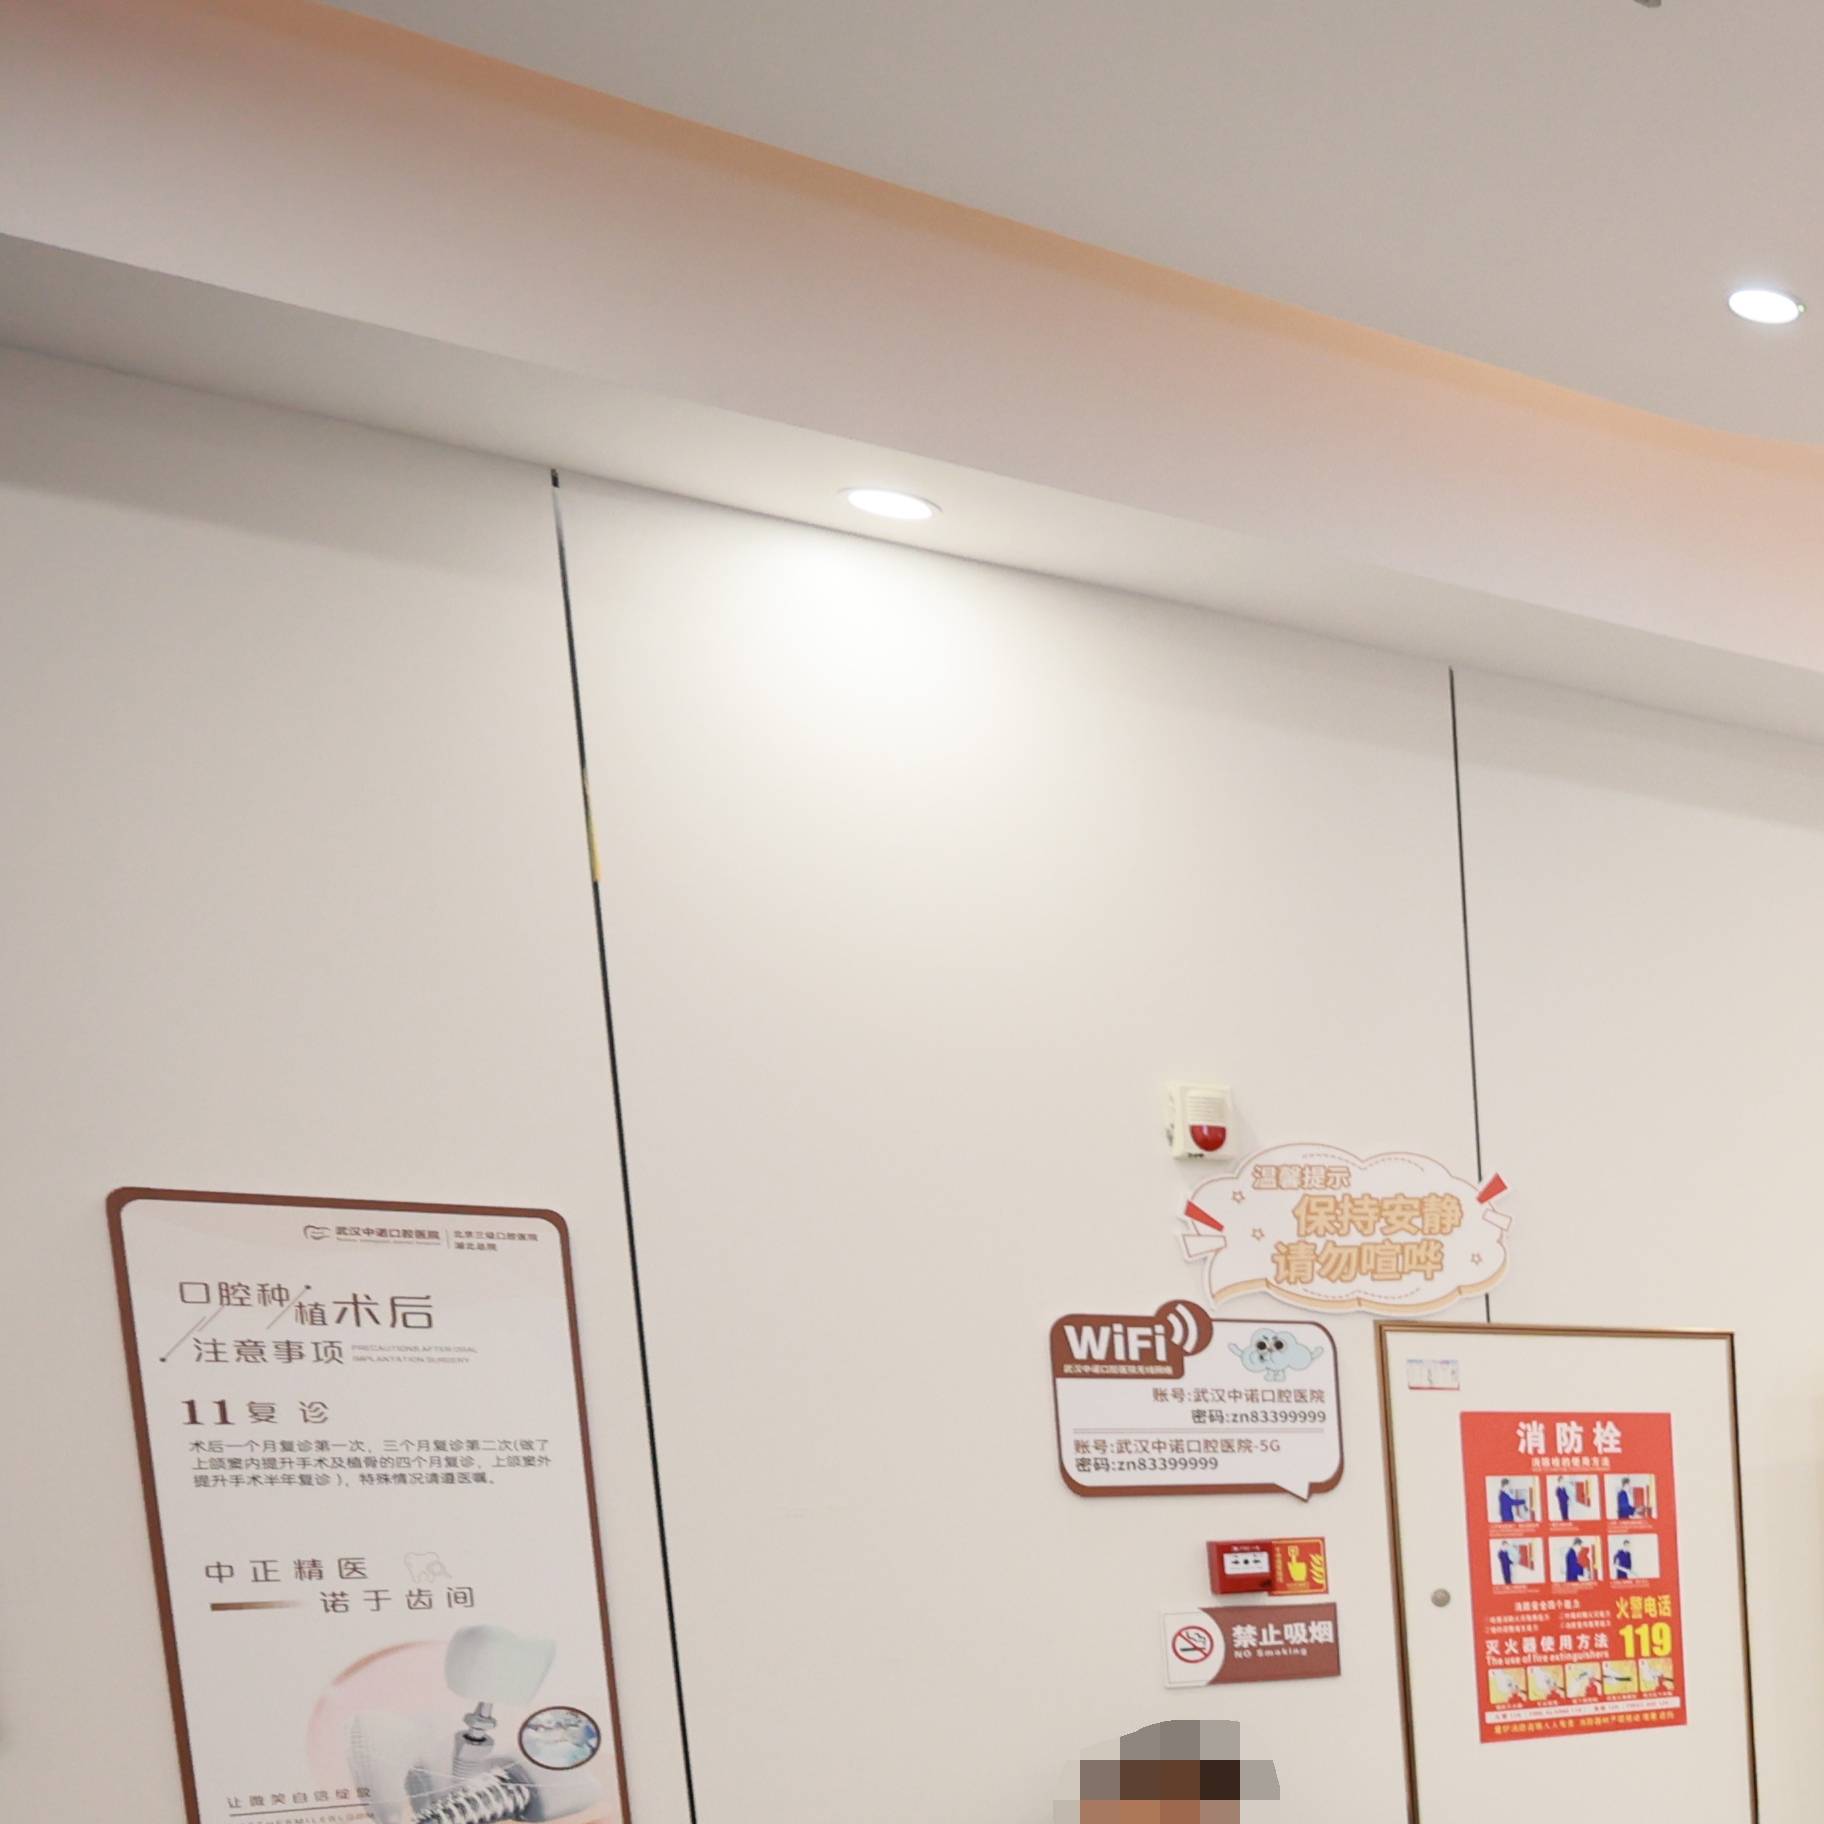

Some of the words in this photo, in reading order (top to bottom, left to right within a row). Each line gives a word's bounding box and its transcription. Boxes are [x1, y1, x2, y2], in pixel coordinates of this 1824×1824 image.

[1252, 1164, 1351, 1189] 温馨提示
[1293, 1193, 1464, 1236] 保持安静
[1272, 1240, 1444, 1284] 请勿喧哗
[194, 1338, 344, 1366] 注意事项
[1063, 1323, 1168, 1362] WiFi
[1152, 1386, 1326, 1404] 账号:武汉中诺口腔医院
[181, 1399, 236, 1426] 11
[247, 1400, 330, 1425] 复诊
[1191, 1408, 1327, 1425] 密码:zn83399999
[1073, 1437, 1281, 1455] 账号:武汉中诺口腔医院-5G
[1516, 1420, 1622, 1454] 消防栓
[1075, 1455, 1219, 1473] 密码:zn83399999
[205, 1557, 368, 1583] 中正精医
[320, 1586, 475, 1614] 诺于齿间
[1615, 1595, 1671, 1620] 火警电话
[1232, 1620, 1334, 1649] 禁止吸烟
[1486, 1634, 1610, 1656] 灭火器使用方法
[1619, 1621, 1672, 1659] 119
[1234, 1650, 1251, 1659] NO
[1486, 1654, 1503, 1666] The
[1504, 1655, 1521, 1665] use
